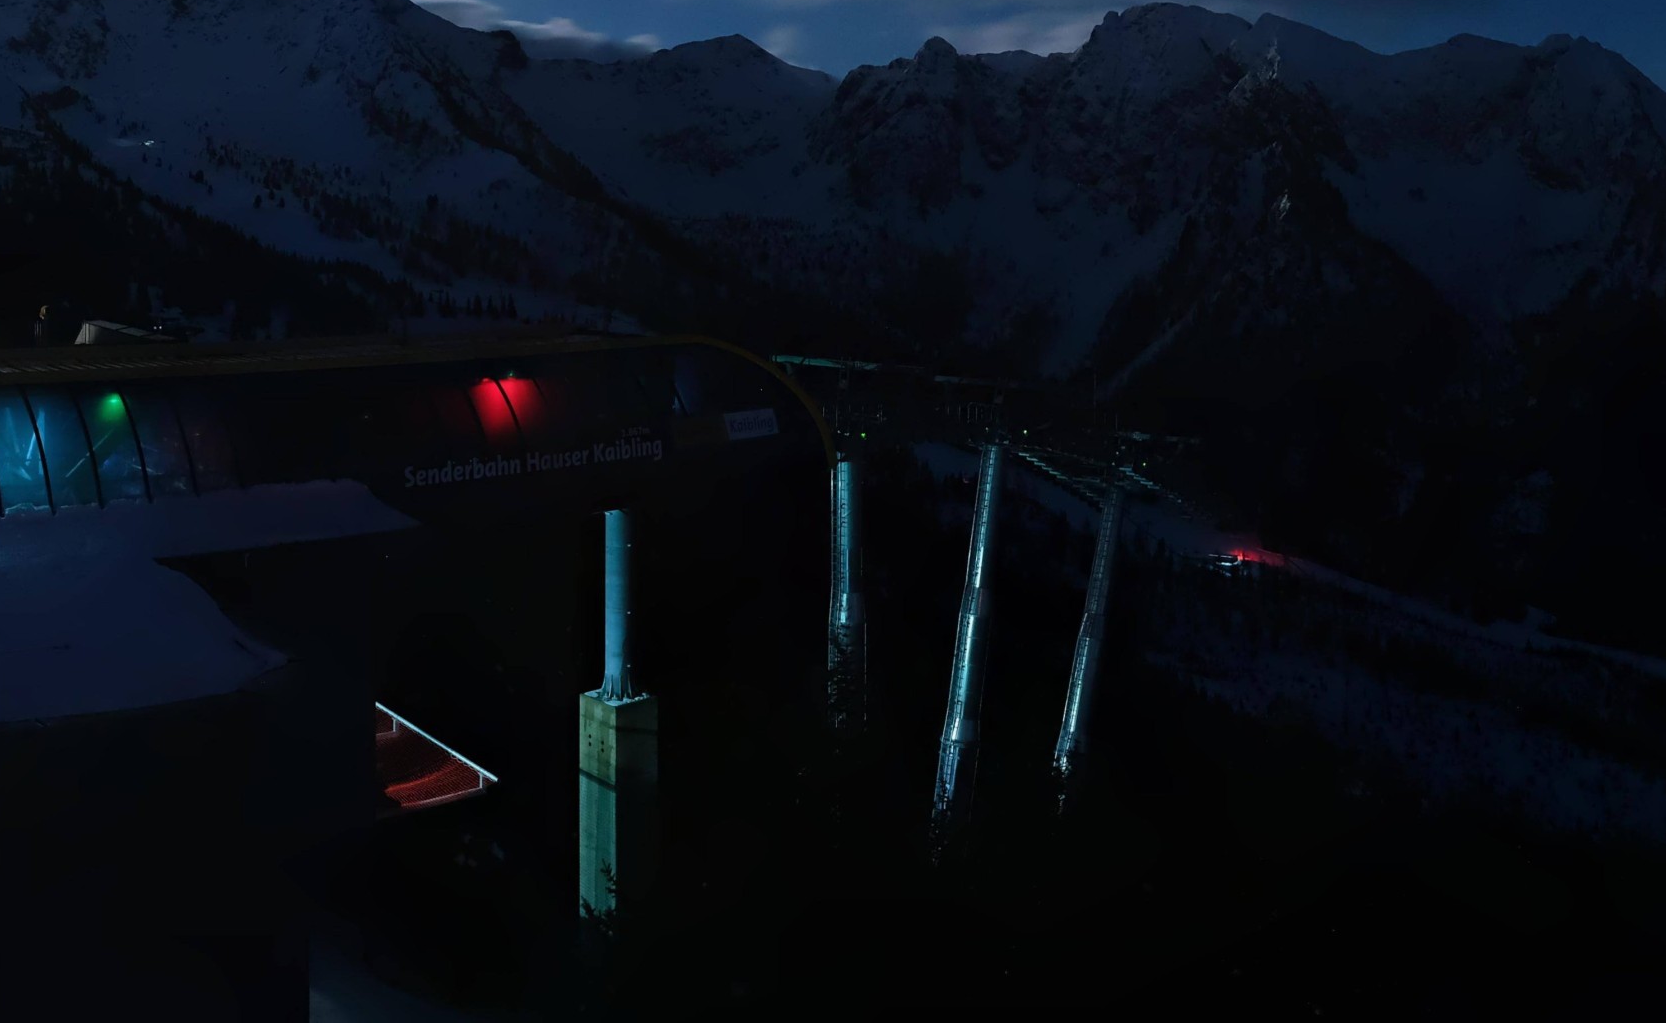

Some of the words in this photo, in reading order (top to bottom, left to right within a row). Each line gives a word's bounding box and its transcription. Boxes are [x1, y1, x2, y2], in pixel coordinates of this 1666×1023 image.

[404, 454, 520, 488] Senderbahn
[526, 447, 589, 473] Hauser
[593, 437, 663, 463] Kaibling
